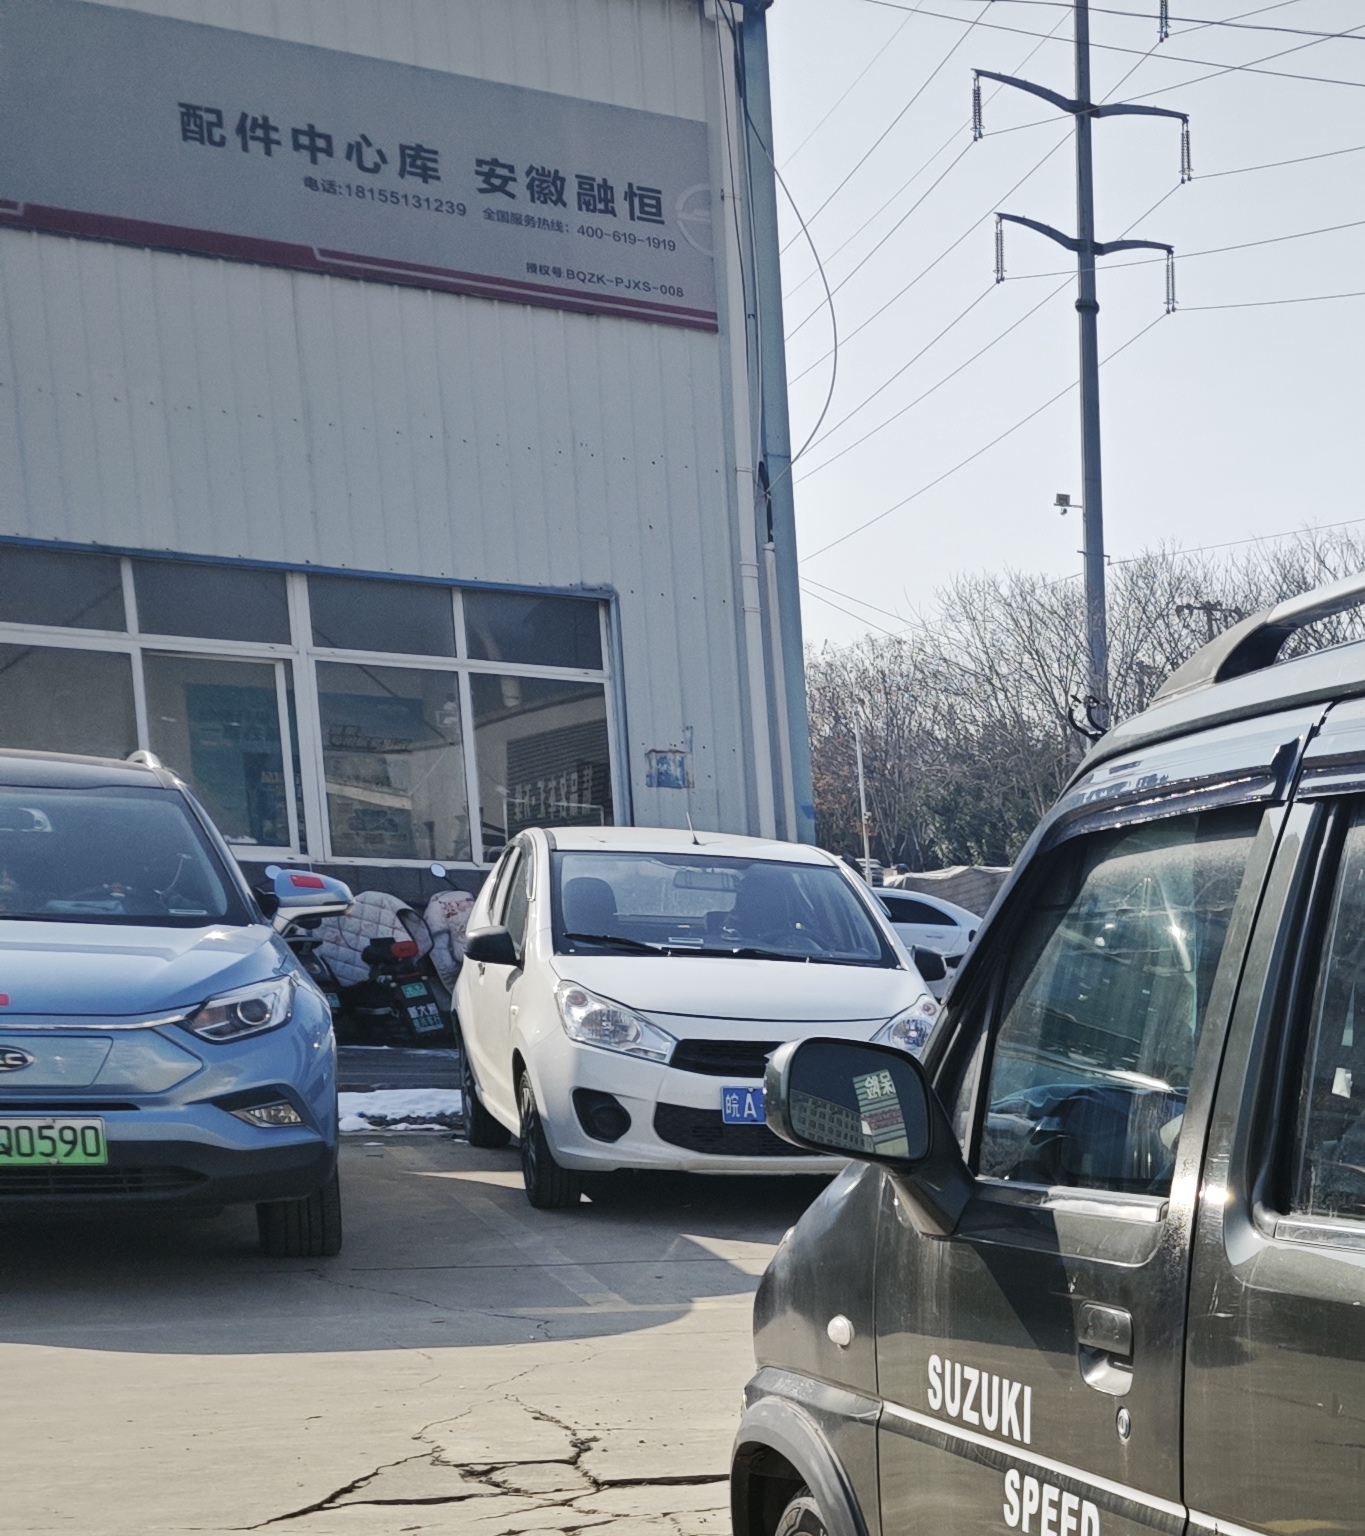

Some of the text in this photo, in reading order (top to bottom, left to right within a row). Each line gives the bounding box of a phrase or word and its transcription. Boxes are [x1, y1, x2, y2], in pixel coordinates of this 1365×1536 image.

[178, 101, 666, 226] 配件中心库 安徽融恒
[927, 1354, 1032, 1445] SUZUKI
